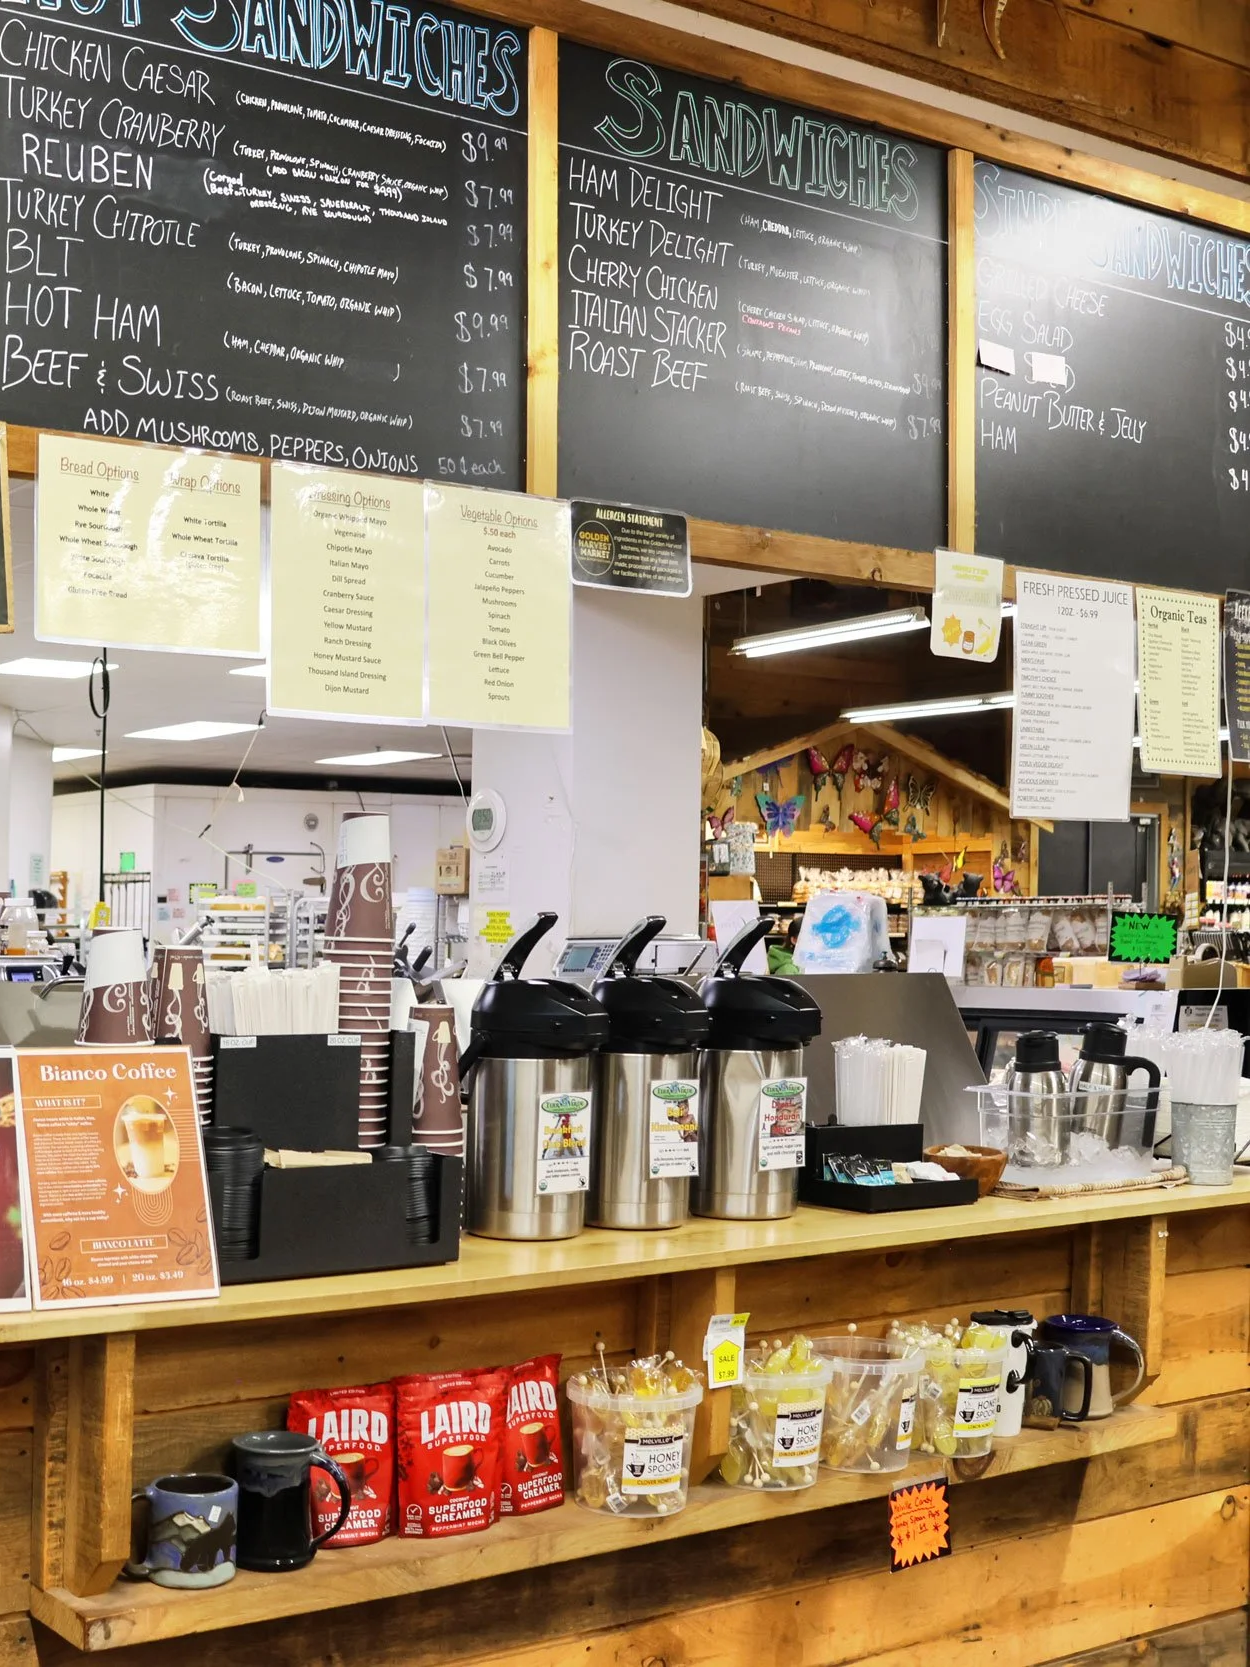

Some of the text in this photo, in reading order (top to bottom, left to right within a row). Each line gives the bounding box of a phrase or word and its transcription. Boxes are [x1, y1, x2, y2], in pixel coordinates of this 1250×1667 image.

[0, 18, 216, 106] CHICKEN CAESAR
[0, 74, 226, 158] TURKEY CRANBERRY
[461, 132, 508, 163] $9.99
[593, 57, 919, 222] SANDWICHES
[22, 132, 154, 191] REUBEN
[464, 180, 514, 209] $7.99
[569, 157, 724, 223] HAM DELIGHT
[0, 177, 201, 248] TURKEY CHIPOTLE
[569, 201, 734, 267] TURKEY DELIGHT
[6, 228, 85, 278] BLT
[568, 244, 719, 312] CHERRY CHICKEN
[5, 281, 161, 347] HOT HAM
[454, 310, 509, 343] $9.99
[568, 289, 727, 358] ITALIAN STACKER
[978, 300, 1074, 353] EGG SALAD
[2, 334, 89, 391] BEEF
[118, 354, 220, 402] SWISS
[569, 330, 708, 392] ROAST BEEF
[981, 377, 1147, 443] PEANUT BUTTER JELLY
[83, 408, 419, 474] ADD MUSHROOMS, PEPPERS, ONIONS
[981, 418, 1017, 454] HAM
[60, 457, 140, 482] Bread Options
[470, 460, 507, 475] each
[89, 489, 110, 498] White
[460, 504, 538, 529] Vegetable Options
[626, 514, 664, 528] STATEMENT
[499, 531, 516, 539] each
[578, 531, 610, 542] GOLDEN
[578, 539, 612, 551] HARVEST
[487, 544, 513, 554] Avocado
[580, 548, 610, 559] MARKET
[329, 559, 369, 570] Italian Mayo
[344, 576, 366, 585] Spread
[1022, 580, 1129, 606] FRESH PRESSED JUICE
[322, 589, 374, 601] Cranberry Sauce
[1079, 607, 1099, 619] $6.99
[1149, 604, 1208, 625] Organic Teas
[323, 621, 373, 632] Yellow Mustard
[473, 650, 525, 662] Green Bell Pepper
[308, 667, 387, 682] Thousand Island Dressing
[40, 1063, 177, 1082] Bianco Coffee
[764, 1112, 800, 1122] Honduran
[718, 1355, 735, 1363] SALE
[718, 1370, 735, 1379] $7.99
[506, 1380, 558, 1422] LAIRD
[307, 1408, 388, 1445] LAIRD
[421, 1401, 492, 1443] LAIRD
[647, 1463, 680, 1474] SPOONS
[649, 1451, 680, 1463] HONEY
[516, 1472, 563, 1493] SUPERFOOD
[428, 1498, 488, 1515] SUPERFOOD
